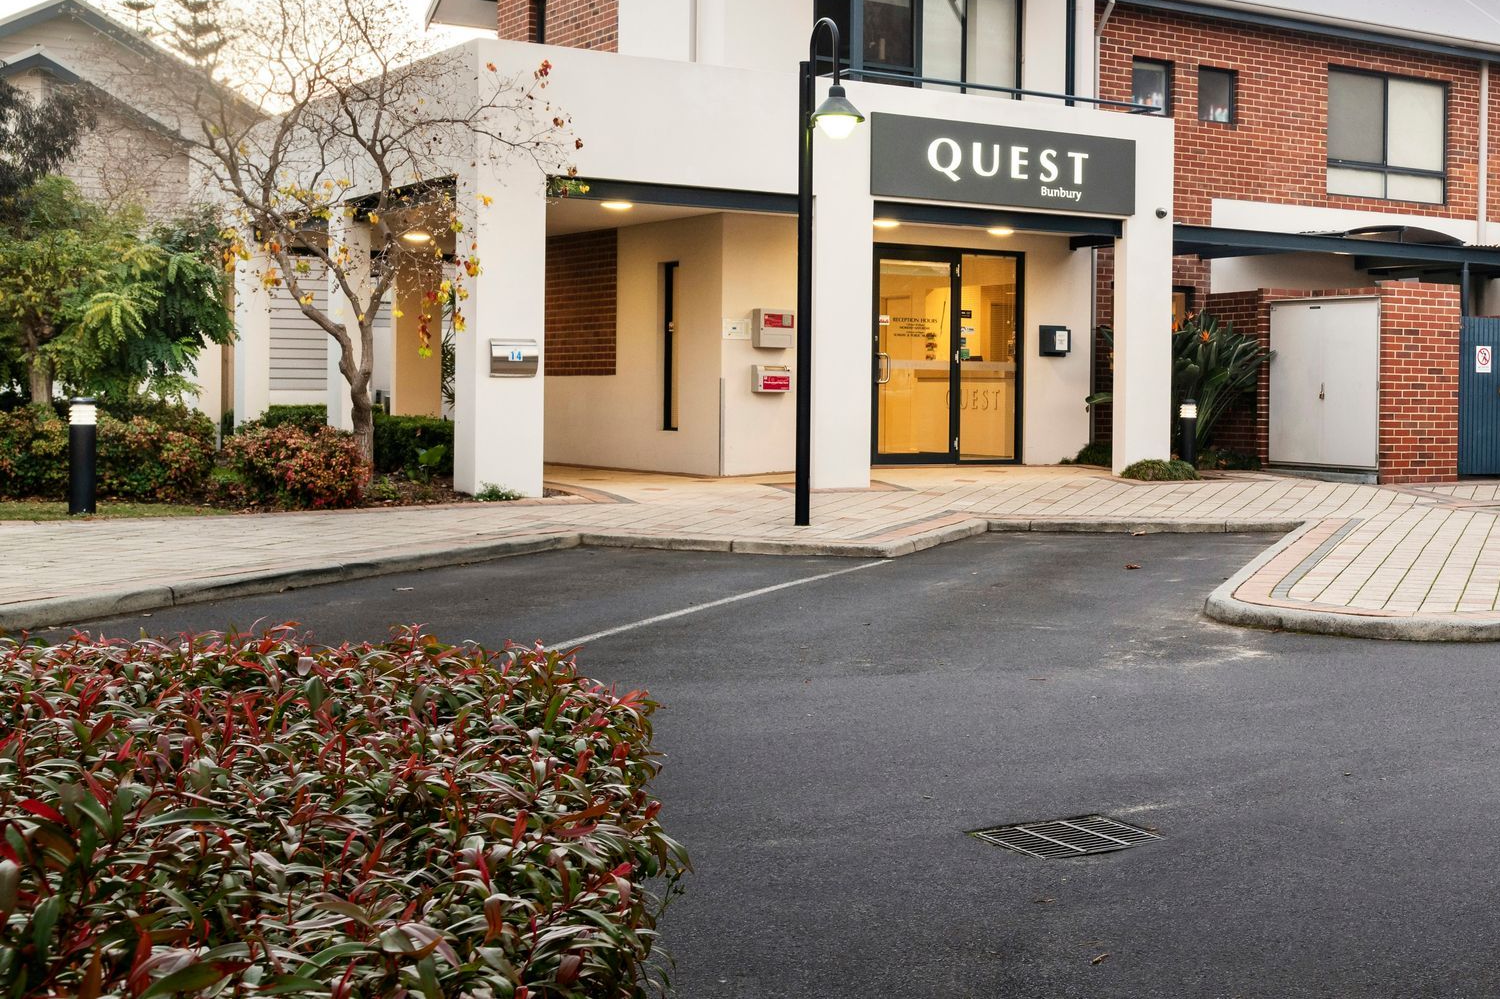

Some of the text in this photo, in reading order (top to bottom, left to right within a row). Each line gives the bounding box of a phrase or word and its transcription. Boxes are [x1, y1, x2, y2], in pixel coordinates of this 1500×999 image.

[927, 137, 1089, 185] QUEST
[1040, 186, 1082, 202] Bunbury
[511, 350, 522, 361] 14
